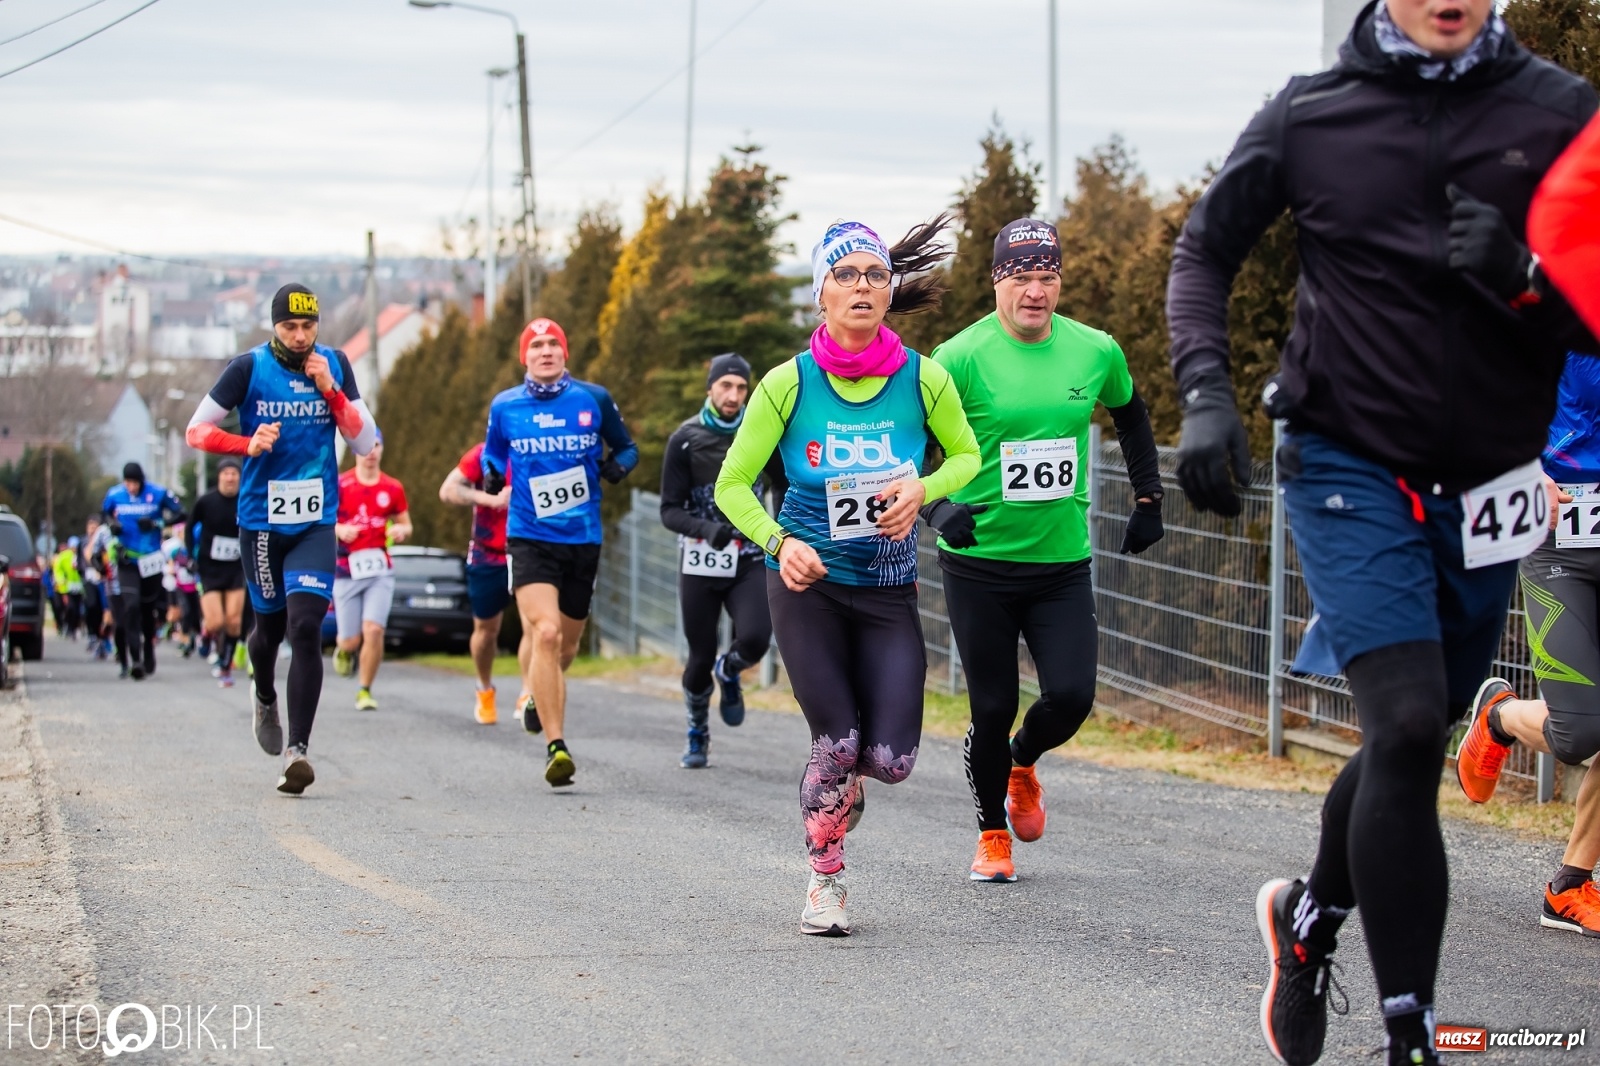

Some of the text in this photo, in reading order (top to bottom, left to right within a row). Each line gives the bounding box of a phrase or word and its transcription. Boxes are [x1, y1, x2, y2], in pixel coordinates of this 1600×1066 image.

[1008, 231, 1051, 243] GDYNIA
[826, 241, 853, 267] VIII
[826, 420, 895, 432] BiegamBoLubię
[826, 433, 901, 468] bbl
[1007, 460, 1074, 490] 268
[272, 495, 320, 515] 216
[537, 482, 585, 509] 396
[834, 495, 898, 527] 28
[1471, 482, 1546, 541] 420
[257, 531, 276, 600] RUNNERS
[688, 550, 733, 570] 363
